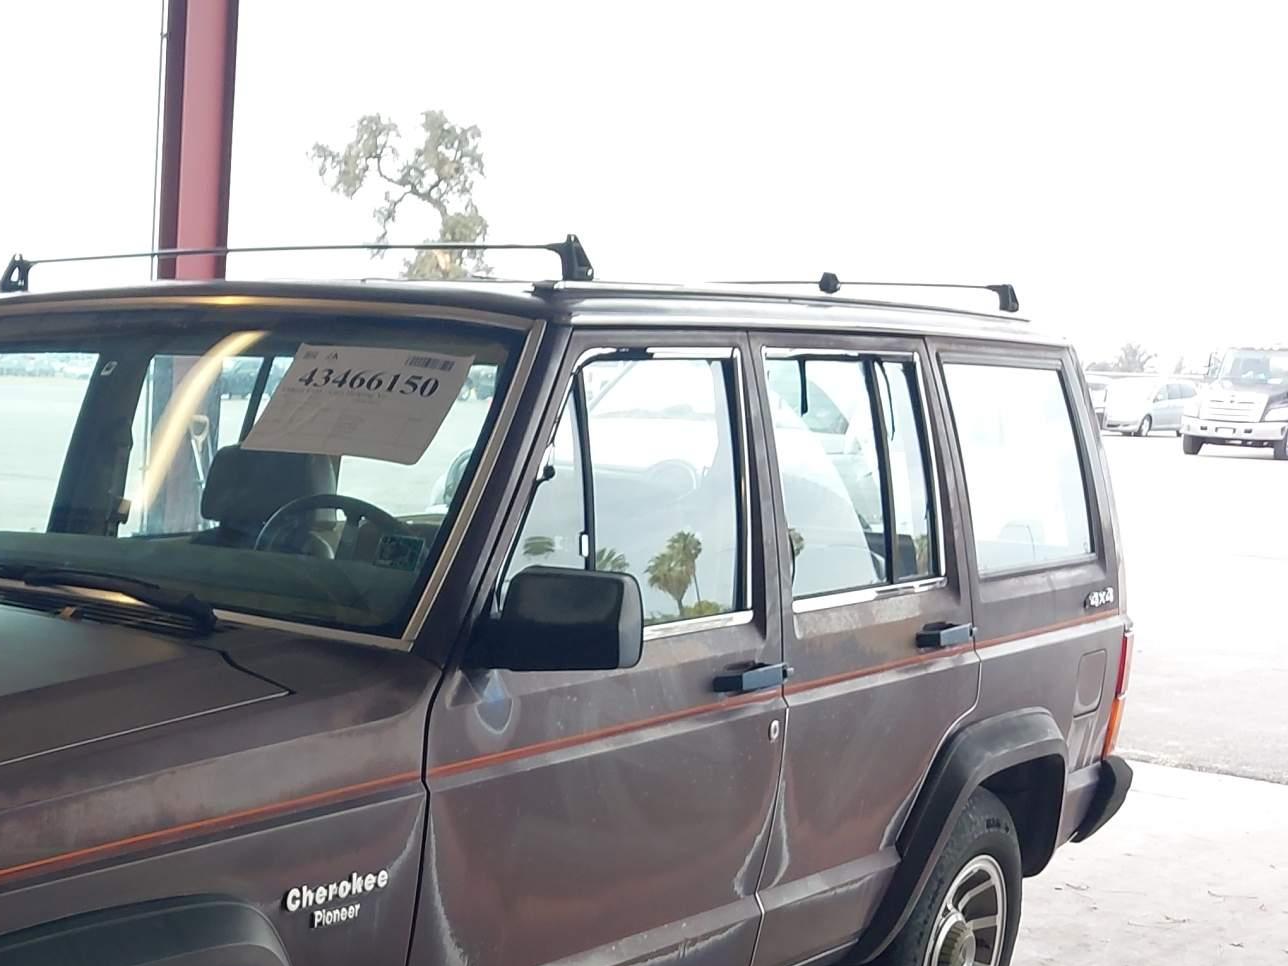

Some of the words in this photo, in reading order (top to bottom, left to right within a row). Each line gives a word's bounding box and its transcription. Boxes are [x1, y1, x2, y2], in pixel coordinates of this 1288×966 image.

[298, 367, 440, 398] 43466150
[1088, 587, 1114, 607] 4x4
[285, 869, 389, 912] Cherokee
[313, 902, 361, 928] Pioneer
